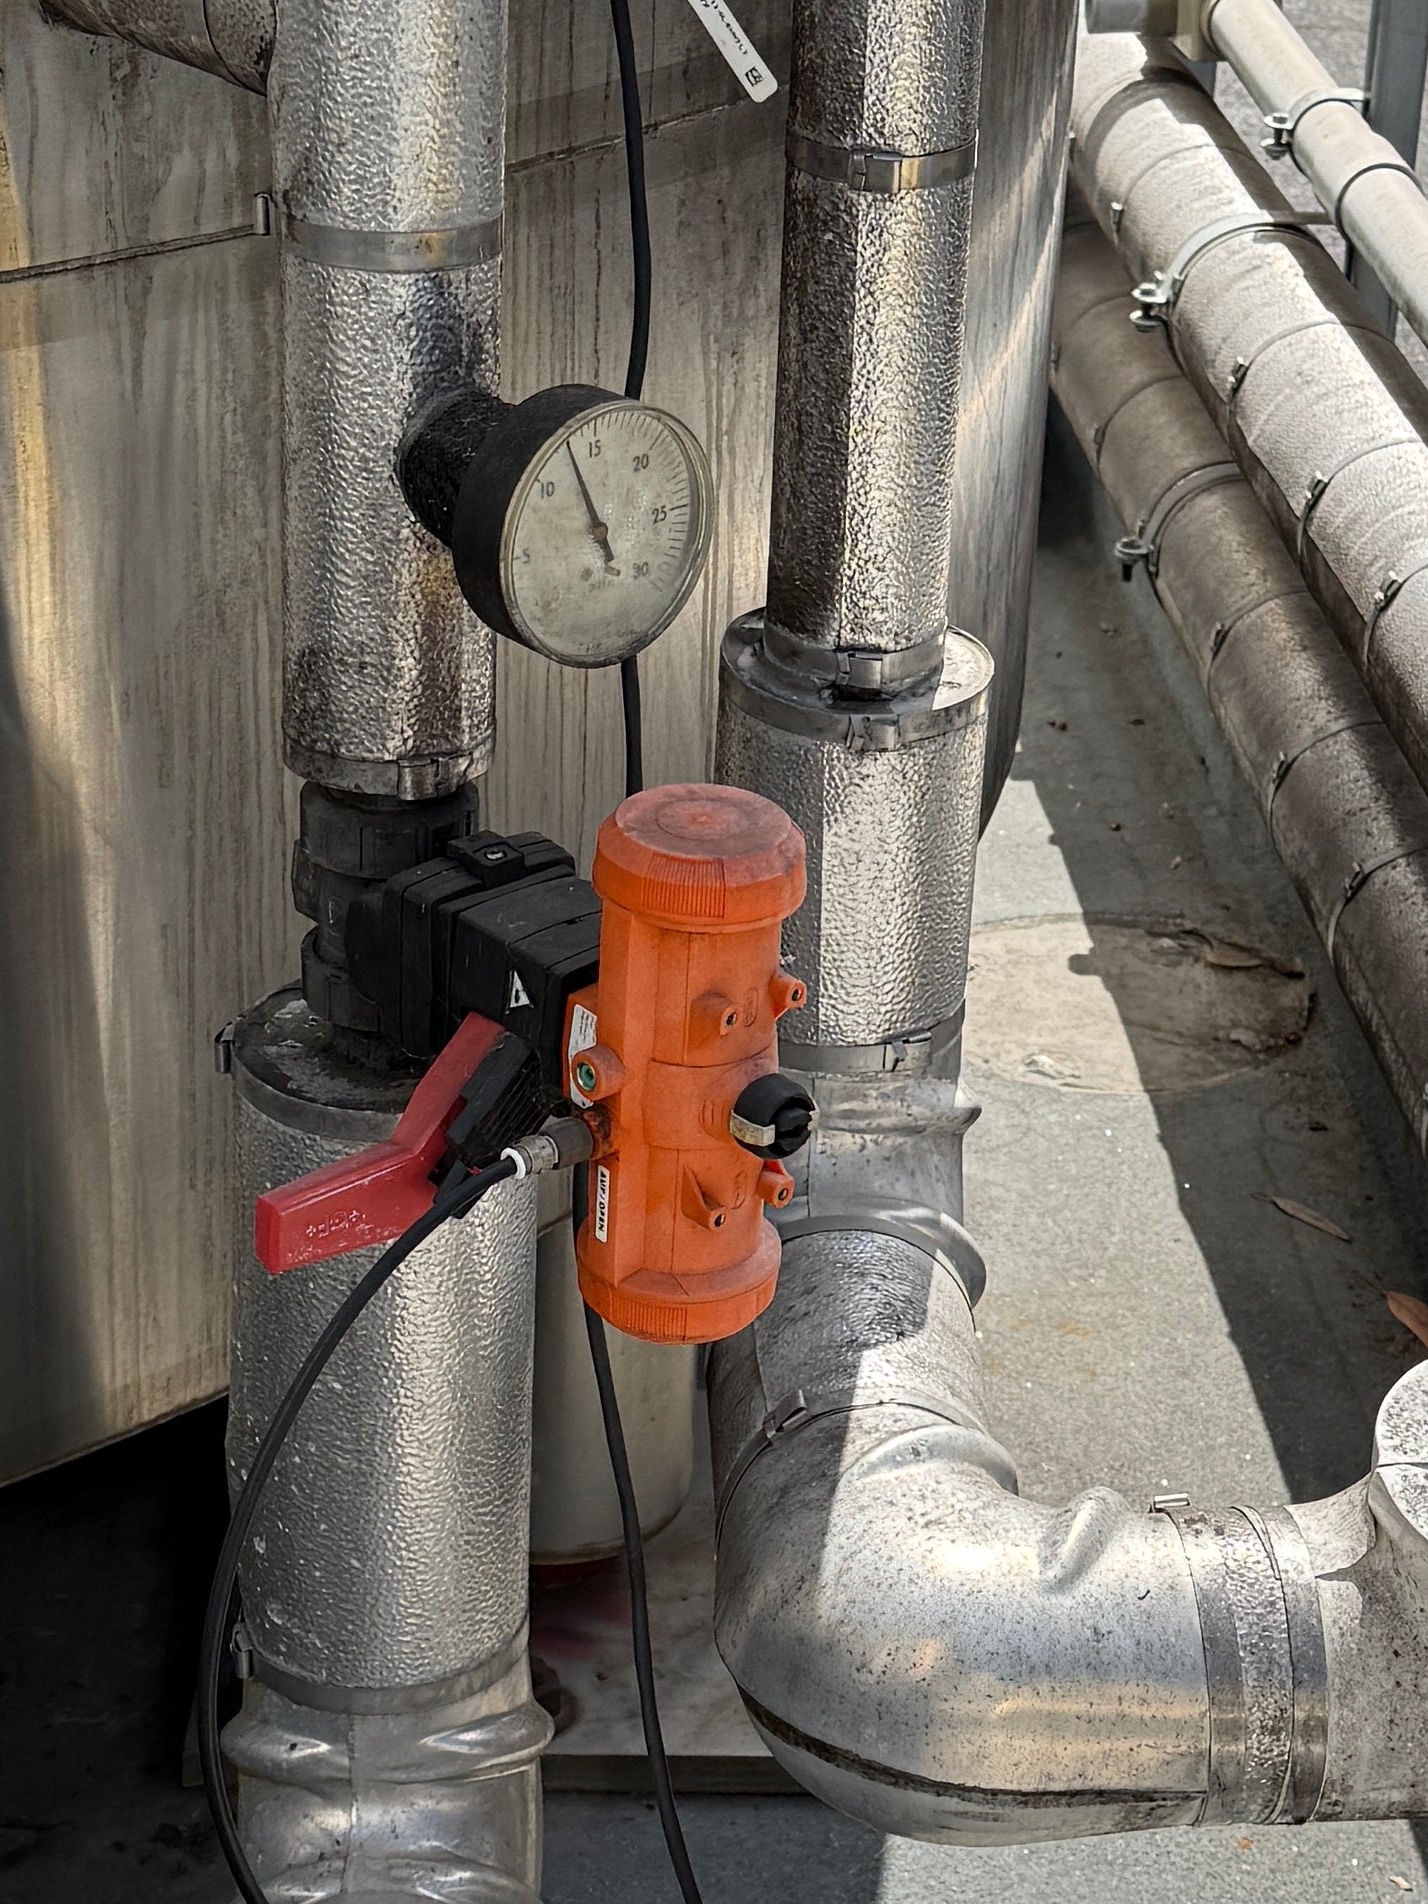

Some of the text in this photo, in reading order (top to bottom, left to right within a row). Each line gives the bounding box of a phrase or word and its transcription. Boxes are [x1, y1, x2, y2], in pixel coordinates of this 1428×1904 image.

[589, 439, 601, 458] 15
[632, 453, 649, 473] 20
[540, 481, 555, 499] 10
[652, 505, 667, 525] 25
[523, 548, 530, 564] 5
[632, 562, 649, 580] 30
